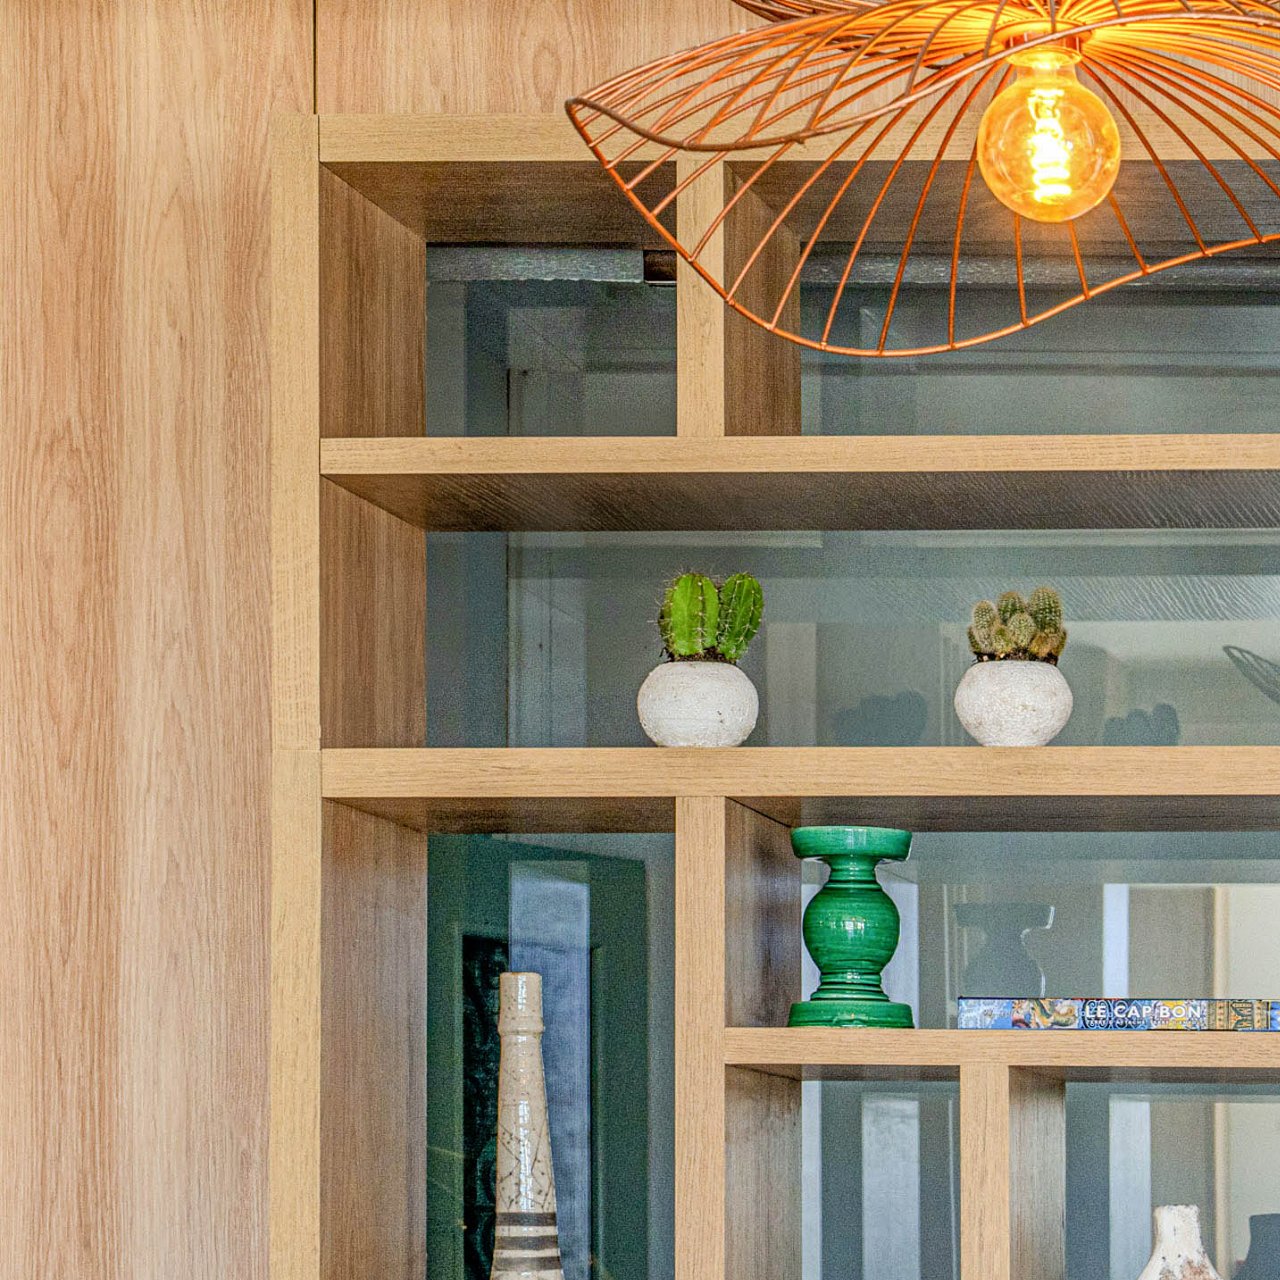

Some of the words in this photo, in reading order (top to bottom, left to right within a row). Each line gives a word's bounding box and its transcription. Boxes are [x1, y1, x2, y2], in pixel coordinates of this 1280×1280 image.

[1085, 1005, 1107, 1018] LE
[1113, 1005, 1152, 1018] CAP
[1159, 1005, 1201, 1018] BON
